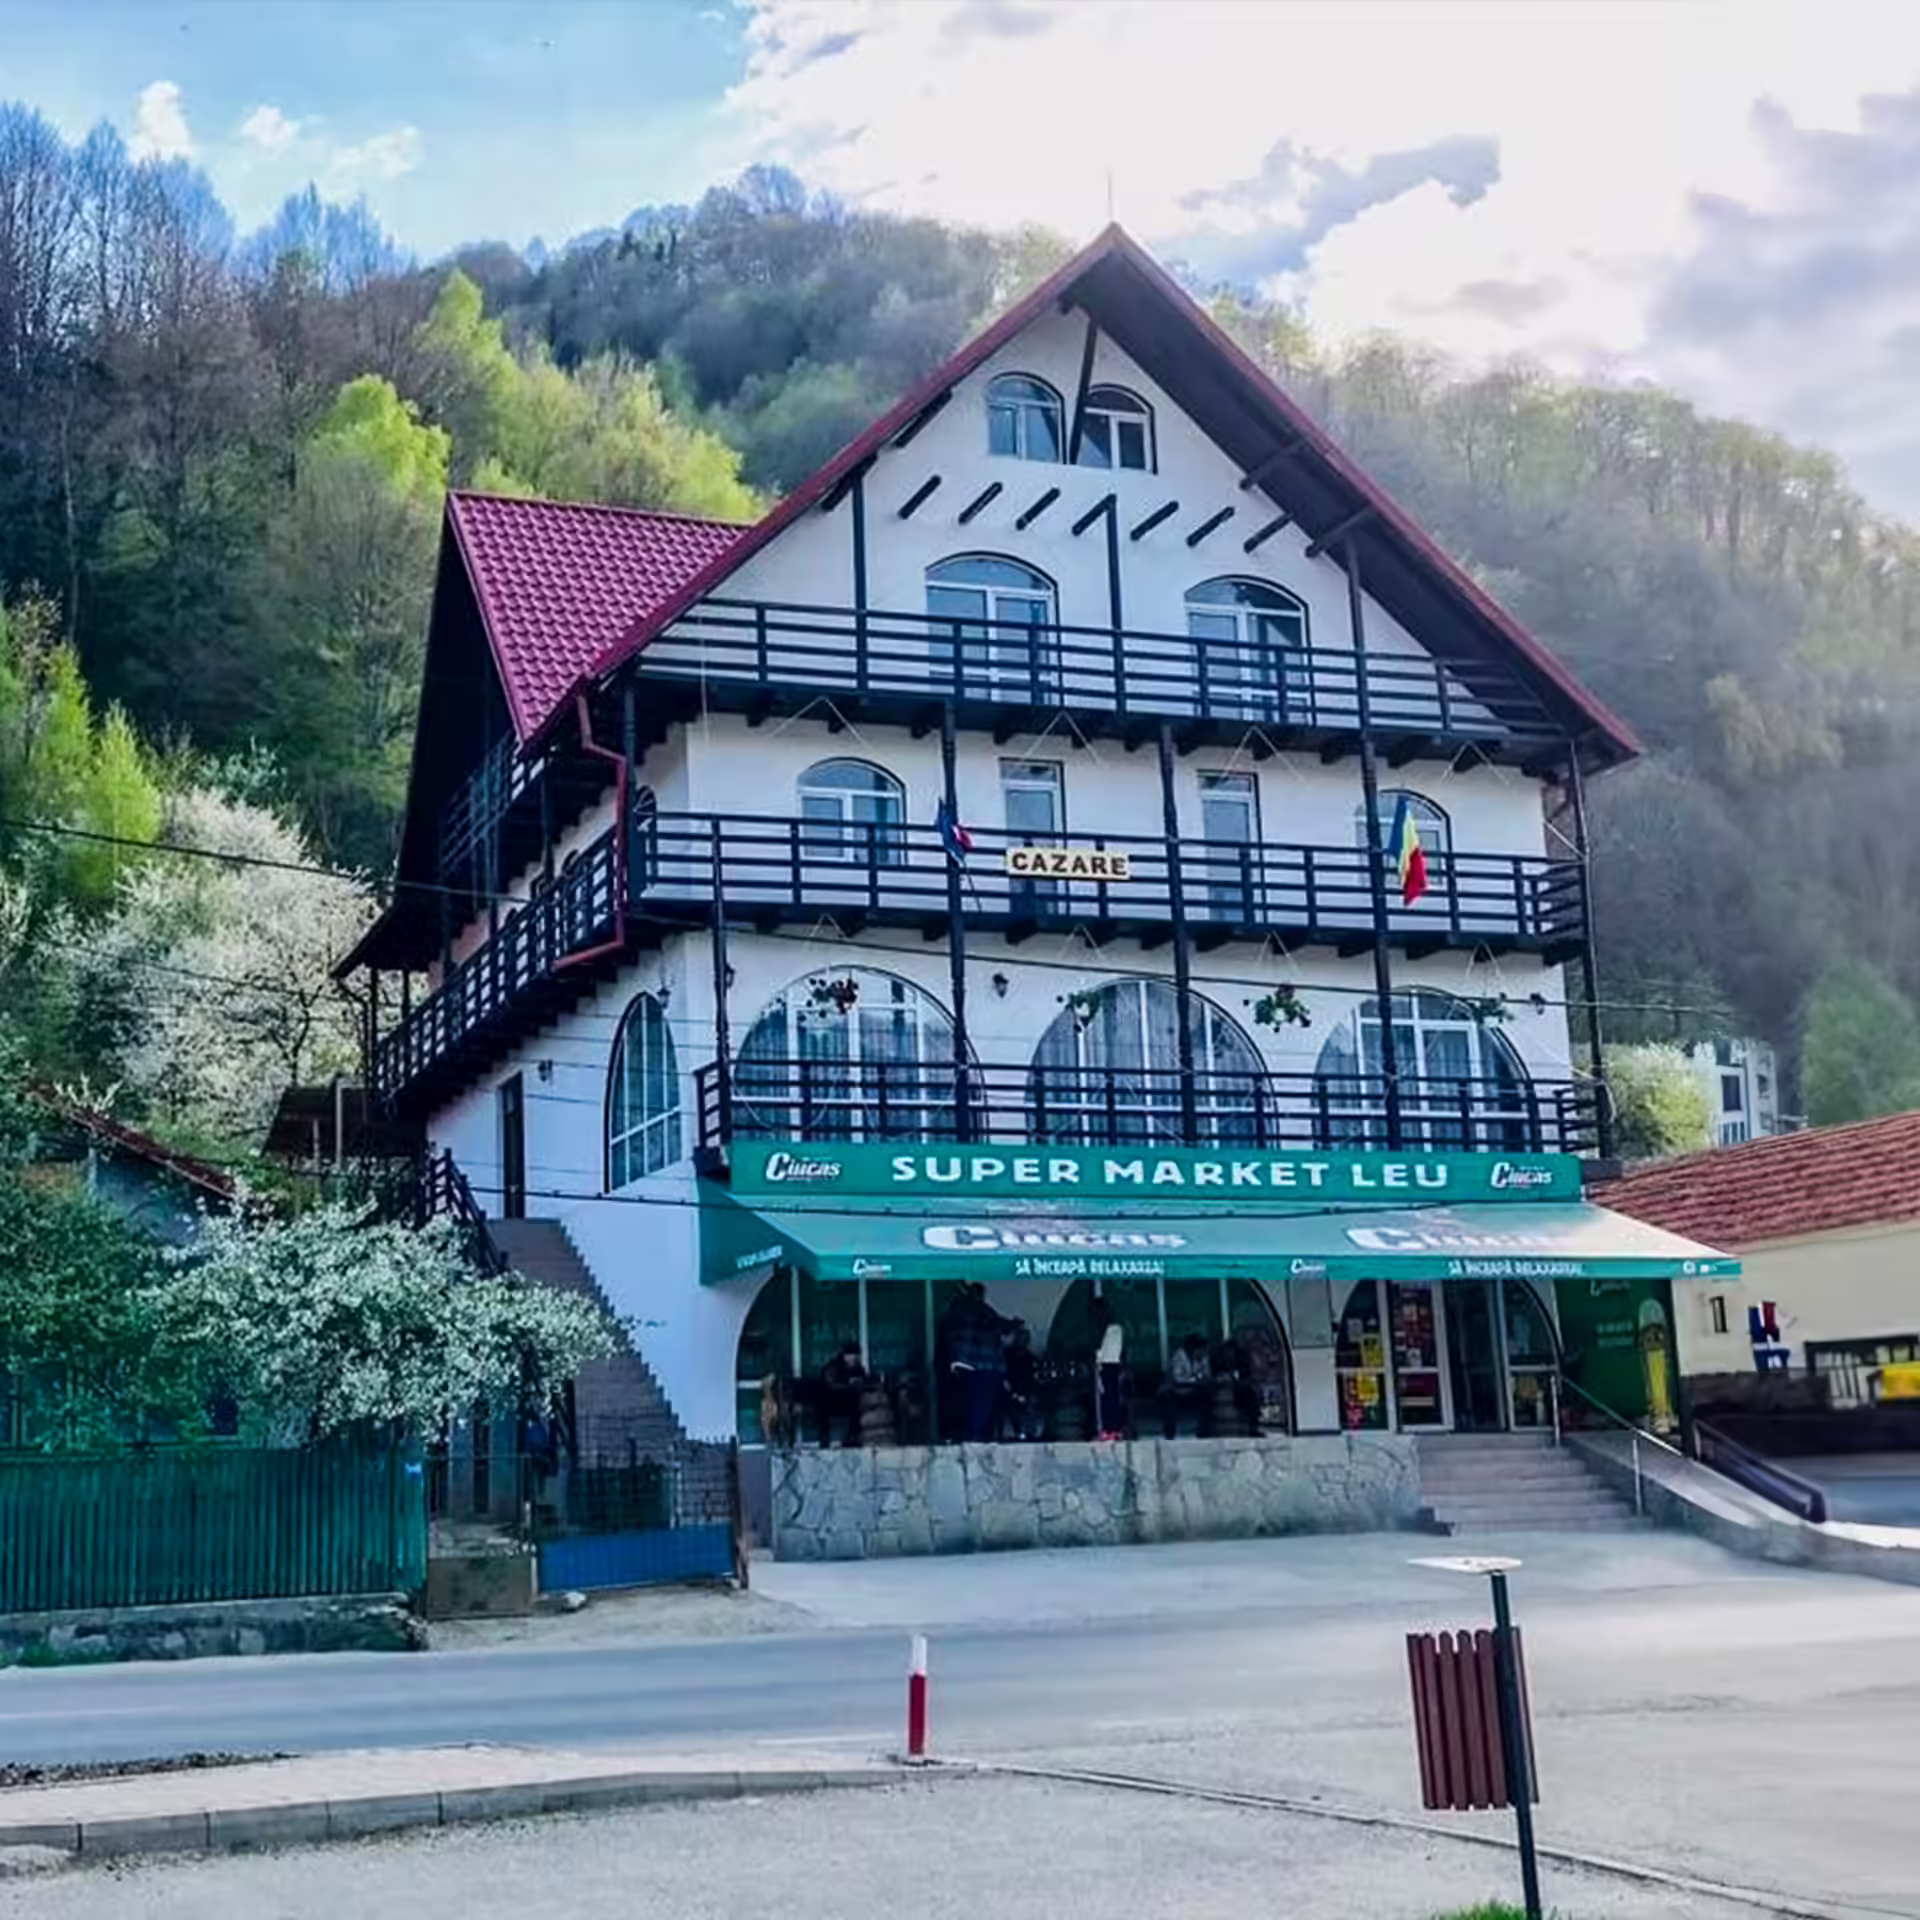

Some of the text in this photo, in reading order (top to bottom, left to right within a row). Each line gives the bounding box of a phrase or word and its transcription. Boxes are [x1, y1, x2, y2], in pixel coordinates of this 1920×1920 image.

[1012, 852, 1128, 876] CAZARE
[892, 1156, 1448, 1188] SUPER MARKET LEU
